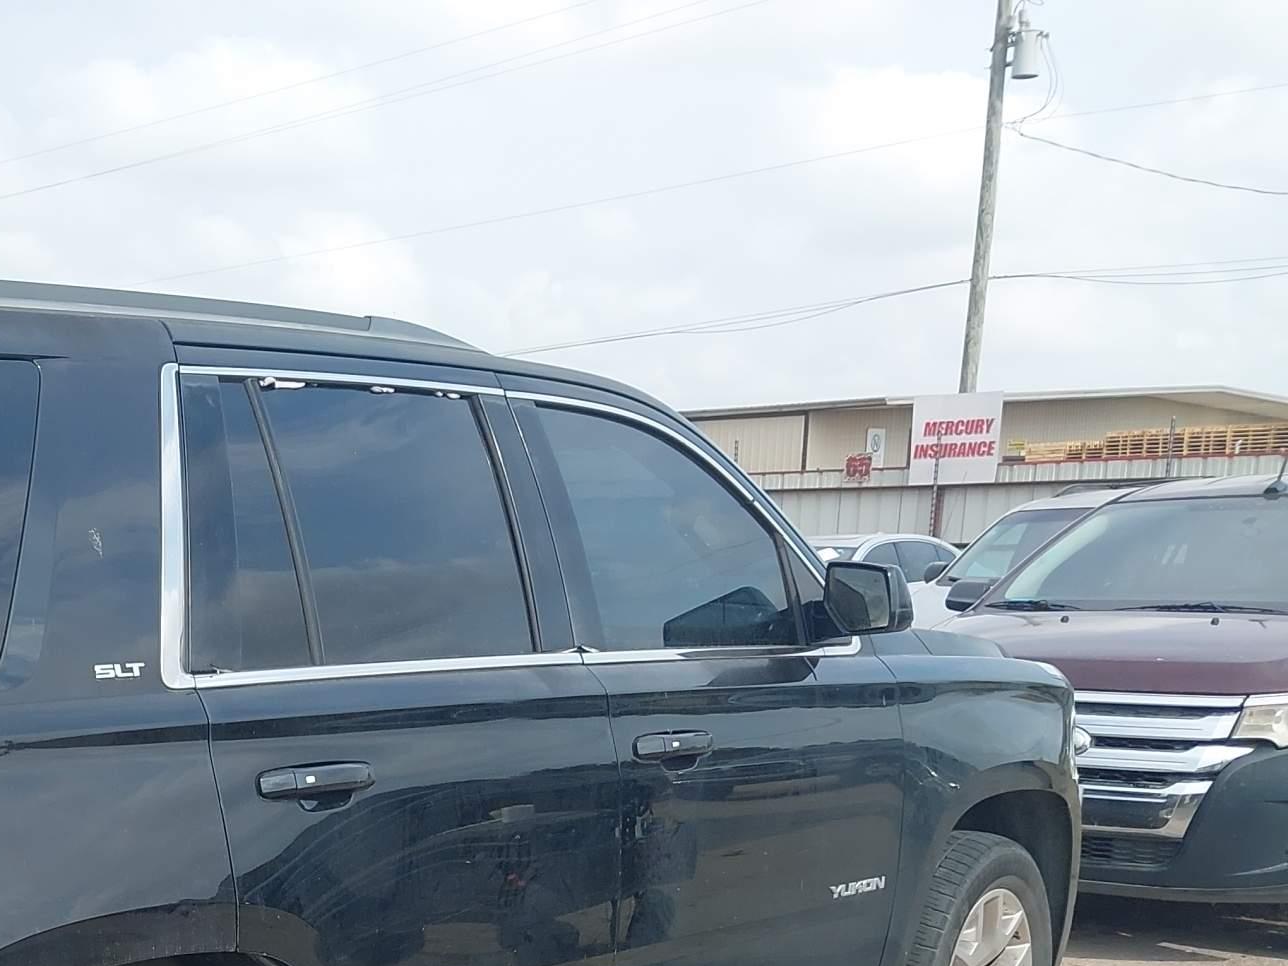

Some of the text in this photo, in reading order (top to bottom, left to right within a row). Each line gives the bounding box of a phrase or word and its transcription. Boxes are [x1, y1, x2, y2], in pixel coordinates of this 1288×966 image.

[923, 418, 996, 437] MERCURY
[913, 441, 996, 459] INSURANCE
[94, 662, 145, 679] SLT
[829, 875, 886, 899] YUKON
